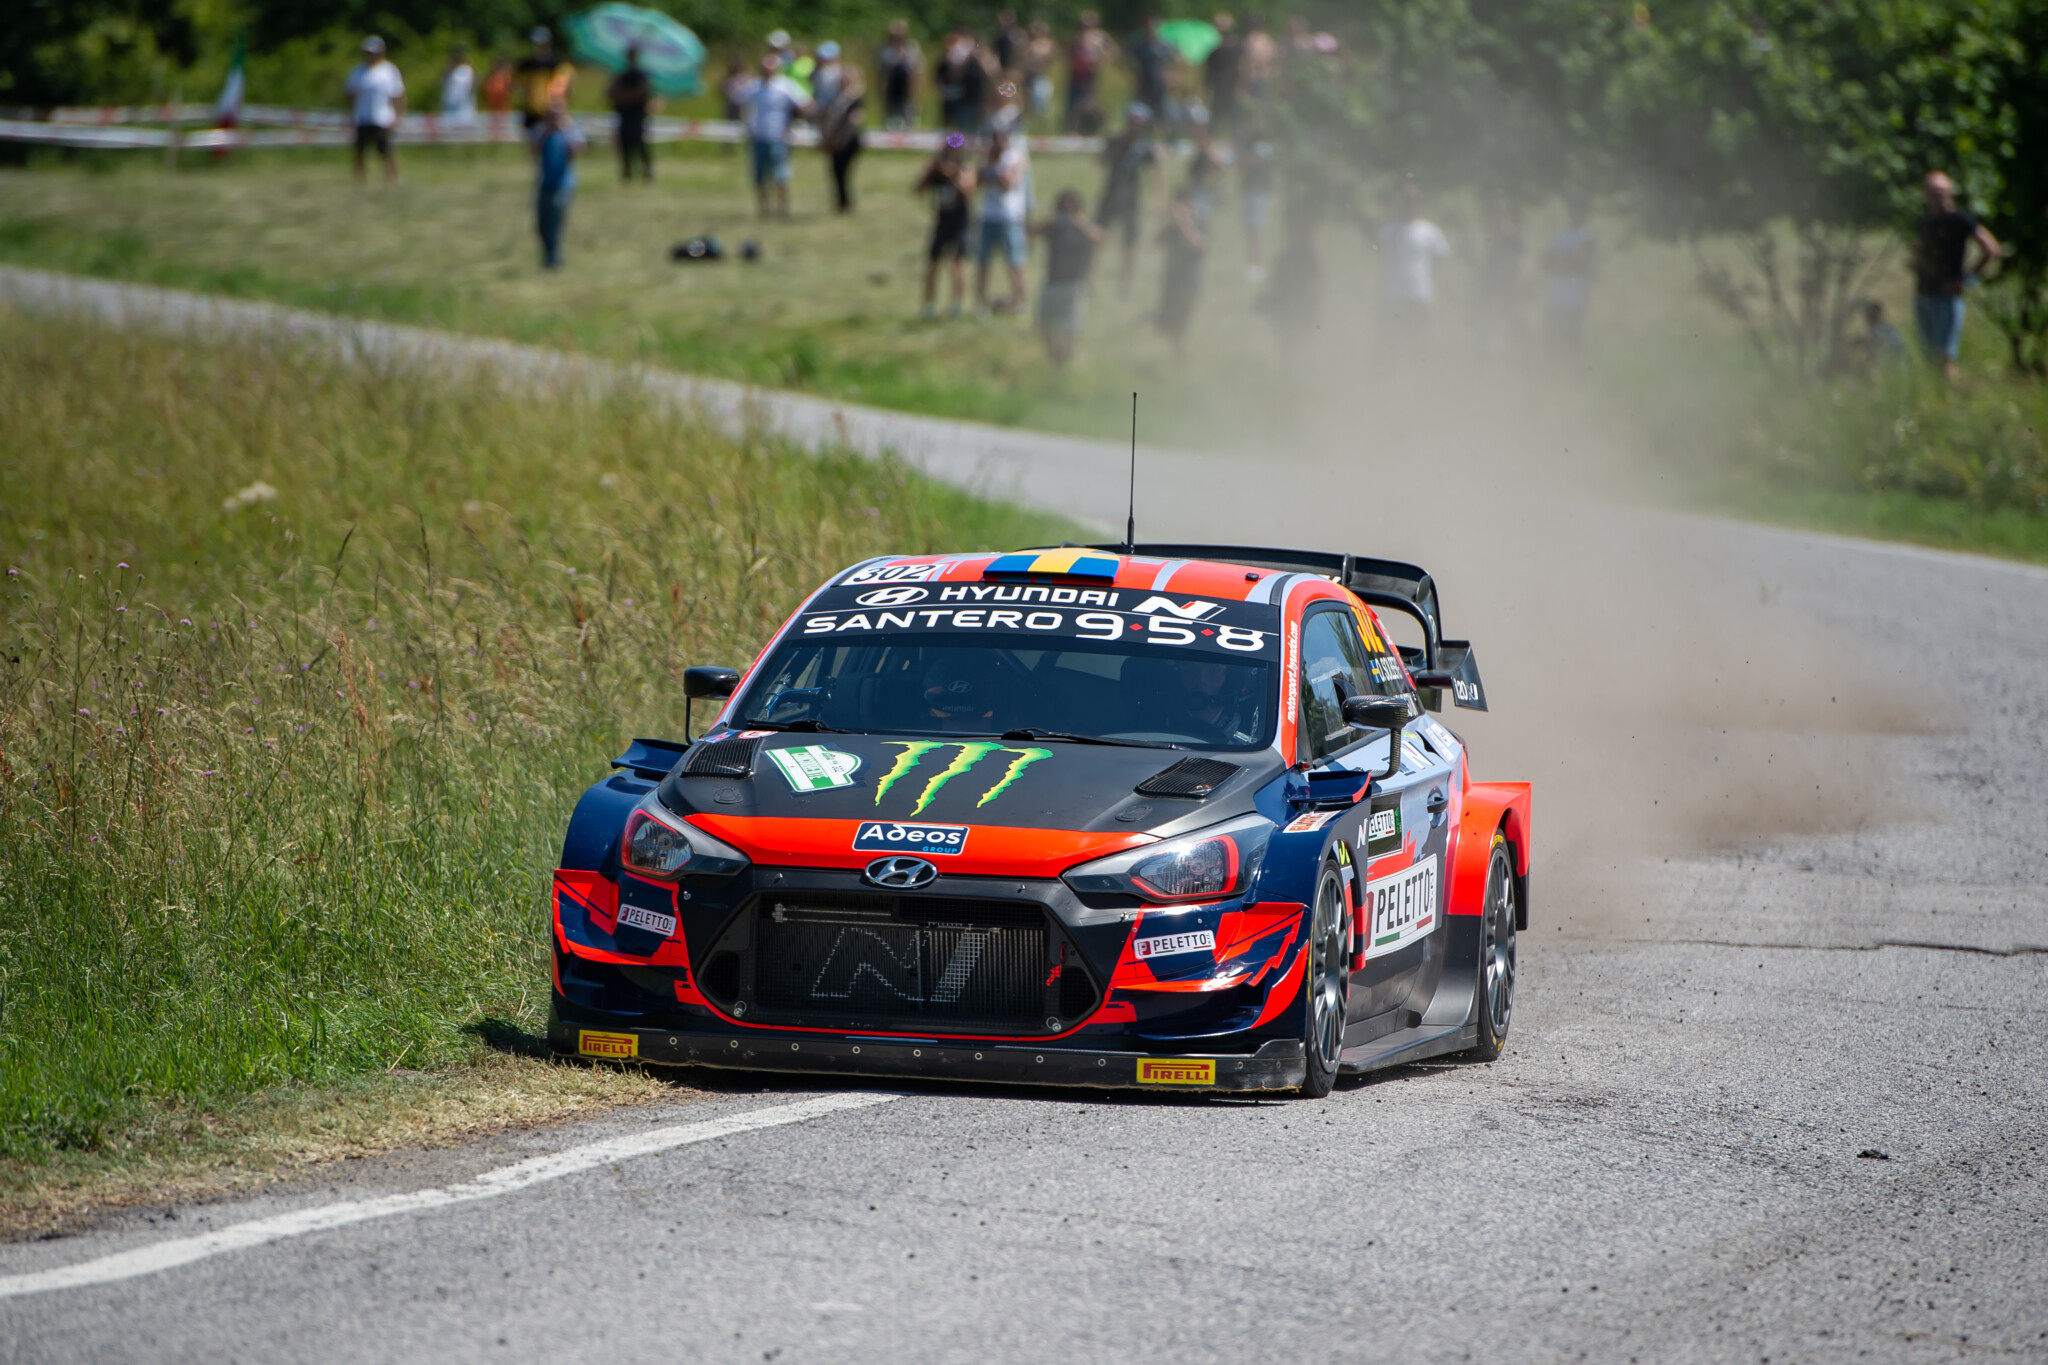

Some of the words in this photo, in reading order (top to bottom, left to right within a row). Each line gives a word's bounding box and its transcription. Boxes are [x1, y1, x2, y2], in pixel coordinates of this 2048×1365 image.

[853, 565, 936, 583] 302
[940, 586, 1120, 607] HYUNDAI
[804, 610, 1063, 634] SANTERO
[860, 824, 964, 845] Adeos
[1376, 868, 1430, 933] PELETTO
[629, 909, 668, 929] PELETTO
[1153, 934, 1207, 951] PELETTO
[582, 1034, 633, 1055] PIRELLI
[1143, 1062, 1210, 1081] PIRELLI
